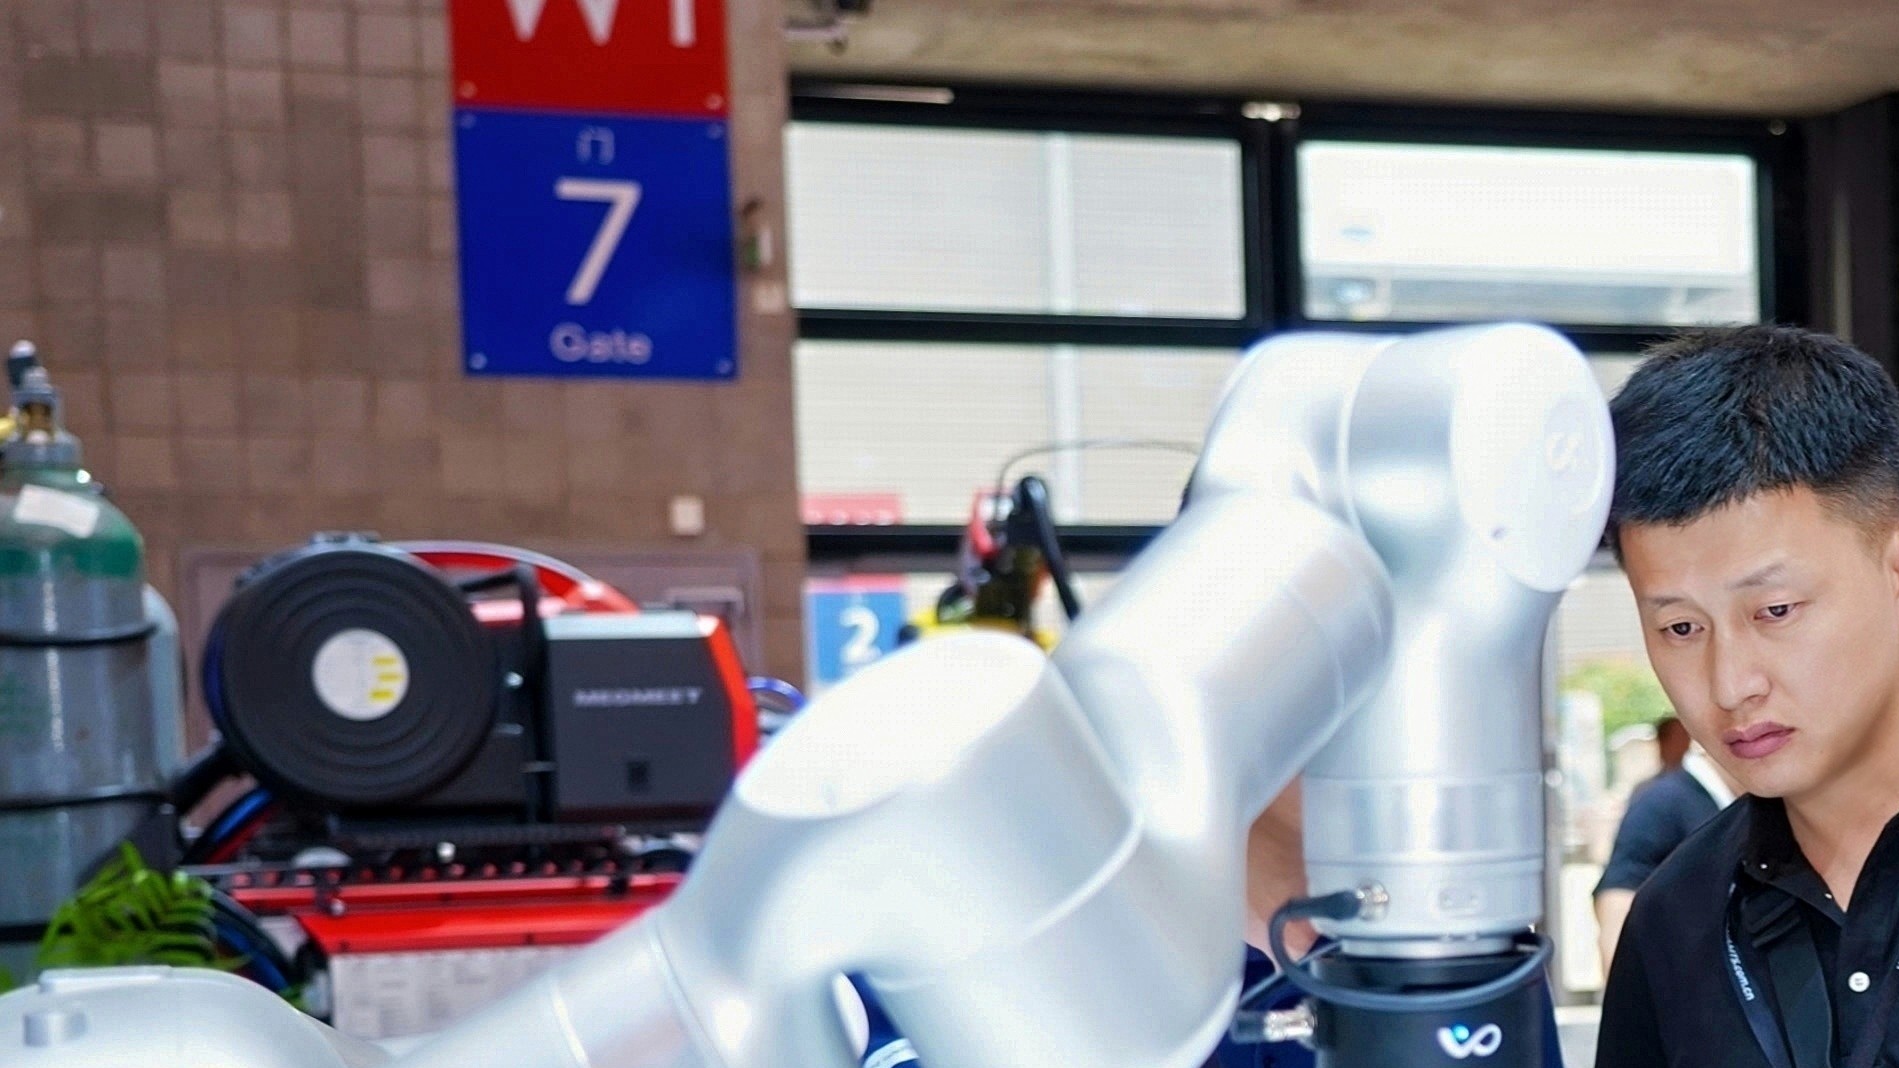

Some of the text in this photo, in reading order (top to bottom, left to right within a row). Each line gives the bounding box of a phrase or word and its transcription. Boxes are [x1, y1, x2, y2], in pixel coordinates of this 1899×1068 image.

[554, 176, 643, 306] 7
[550, 321, 653, 364] Gate
[840, 606, 882, 666] 2
